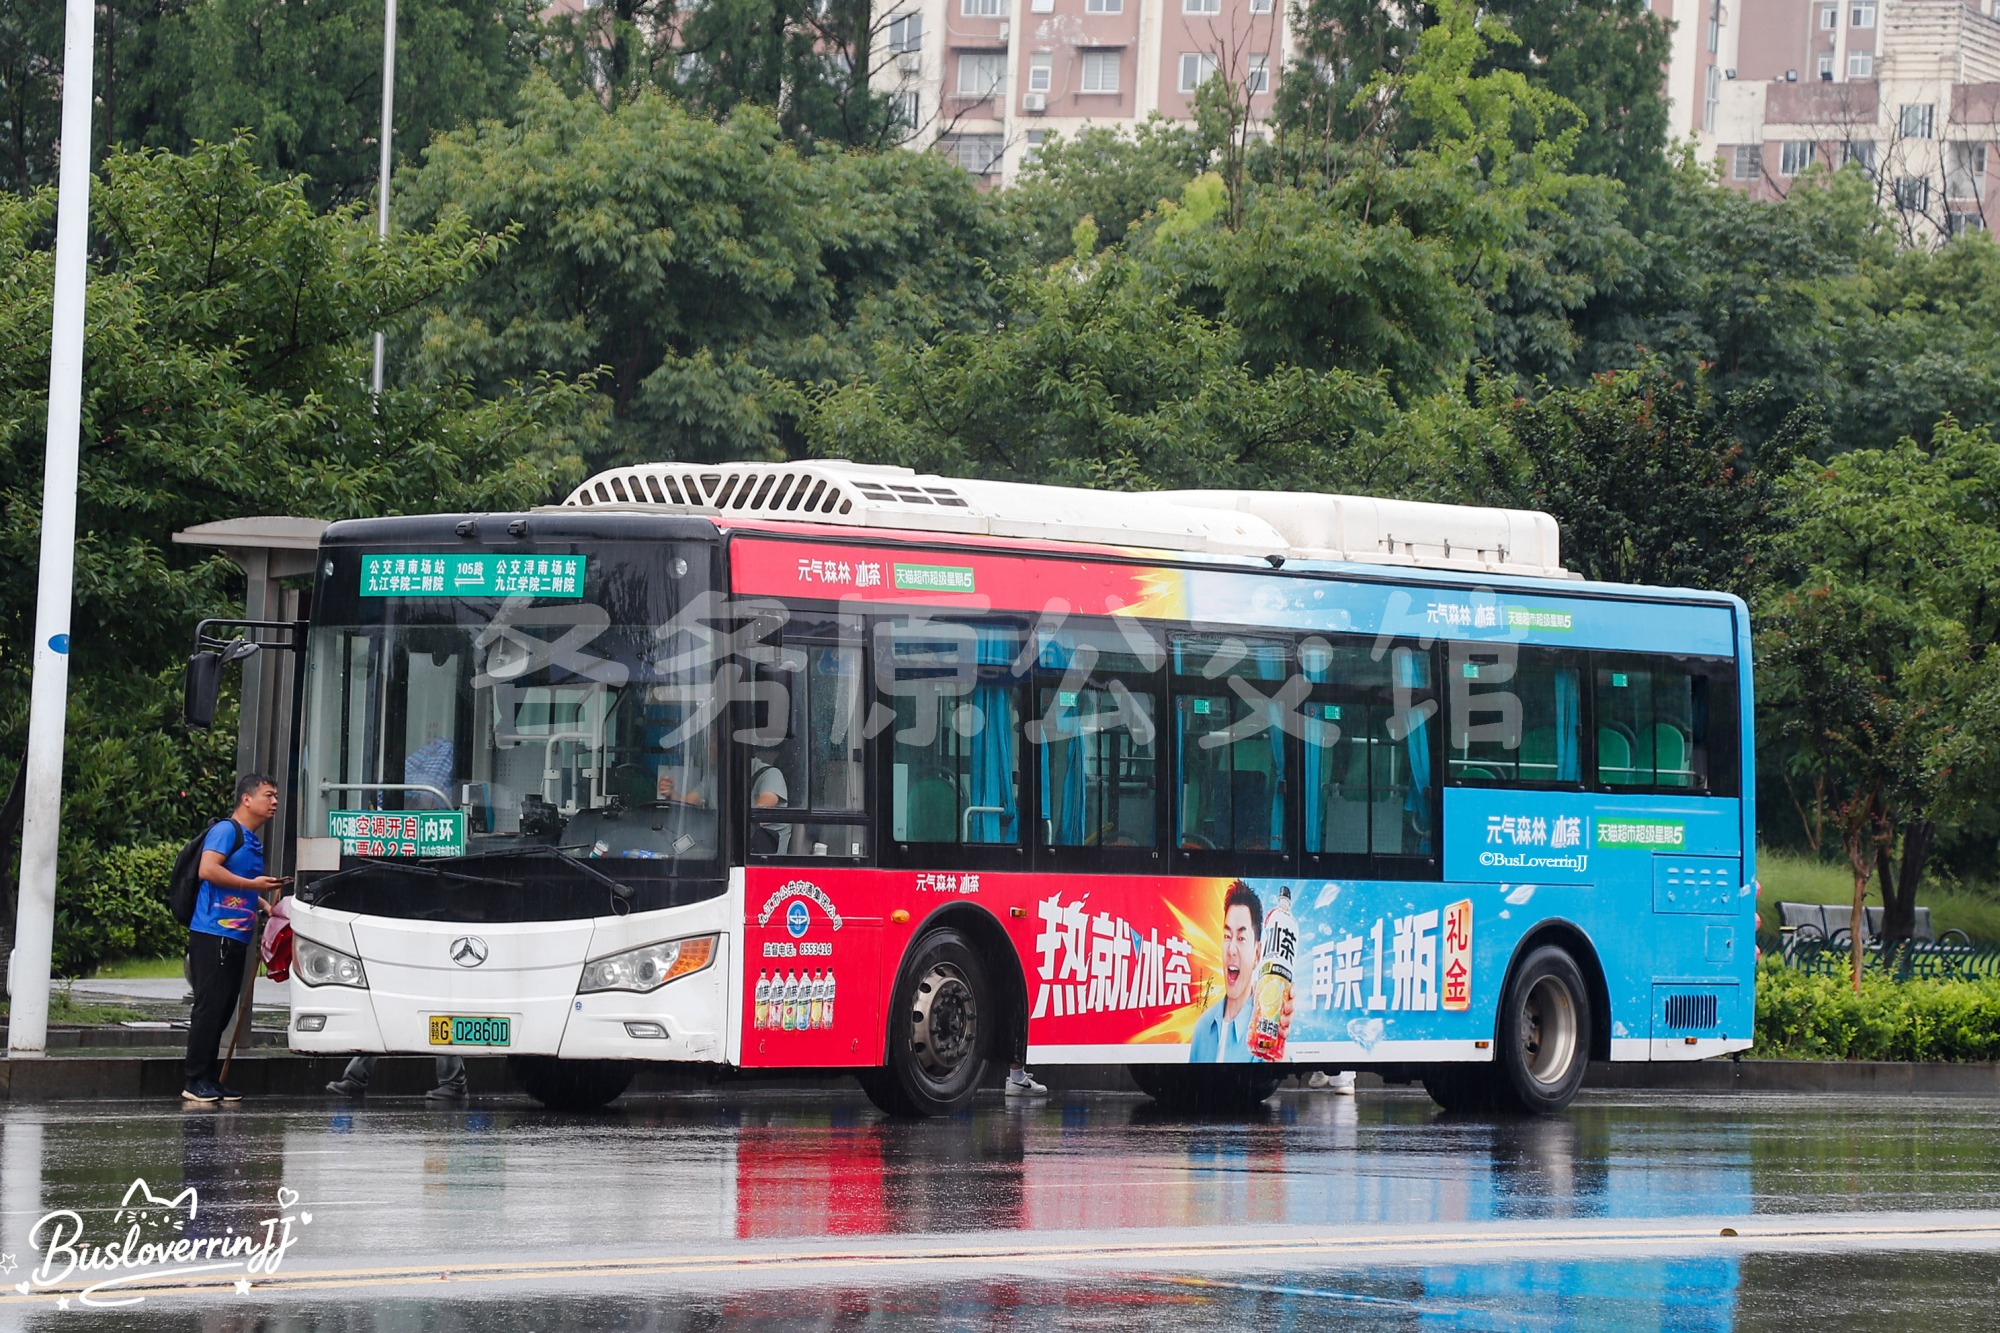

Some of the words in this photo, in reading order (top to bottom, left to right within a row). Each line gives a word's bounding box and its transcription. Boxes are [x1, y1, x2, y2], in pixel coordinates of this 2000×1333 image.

[369, 560, 446, 575] 公交浔南场站
[457, 562, 484, 575] 105路
[496, 560, 577, 576] 公交浔南场站
[798, 559, 851, 584] 元气森林
[855, 560, 881, 587] 冰茶
[896, 568, 972, 588] 天猫超市超级星期5
[368, 576, 444, 591] 九江学院二附院
[495, 577, 575, 593] 九江学院二附院
[1426, 602, 1472, 626] 元气森林
[1487, 815, 1548, 846] 元气森林
[1551, 815, 1581, 849] 冰茶
[1597, 823, 1683, 845] 天猫超市超级星期5
[916, 873, 957, 892] 元气森林
[959, 873, 980, 894] 冰茶
[758, 880, 843, 931] 九江市公共交通集团公司
[799, 942, 832, 956] 8553416
[1030, 890, 1193, 1019] 热就冰茶
[1311, 909, 1439, 1011] 再来1瓶
[1445, 908, 1469, 1003] 礼金
